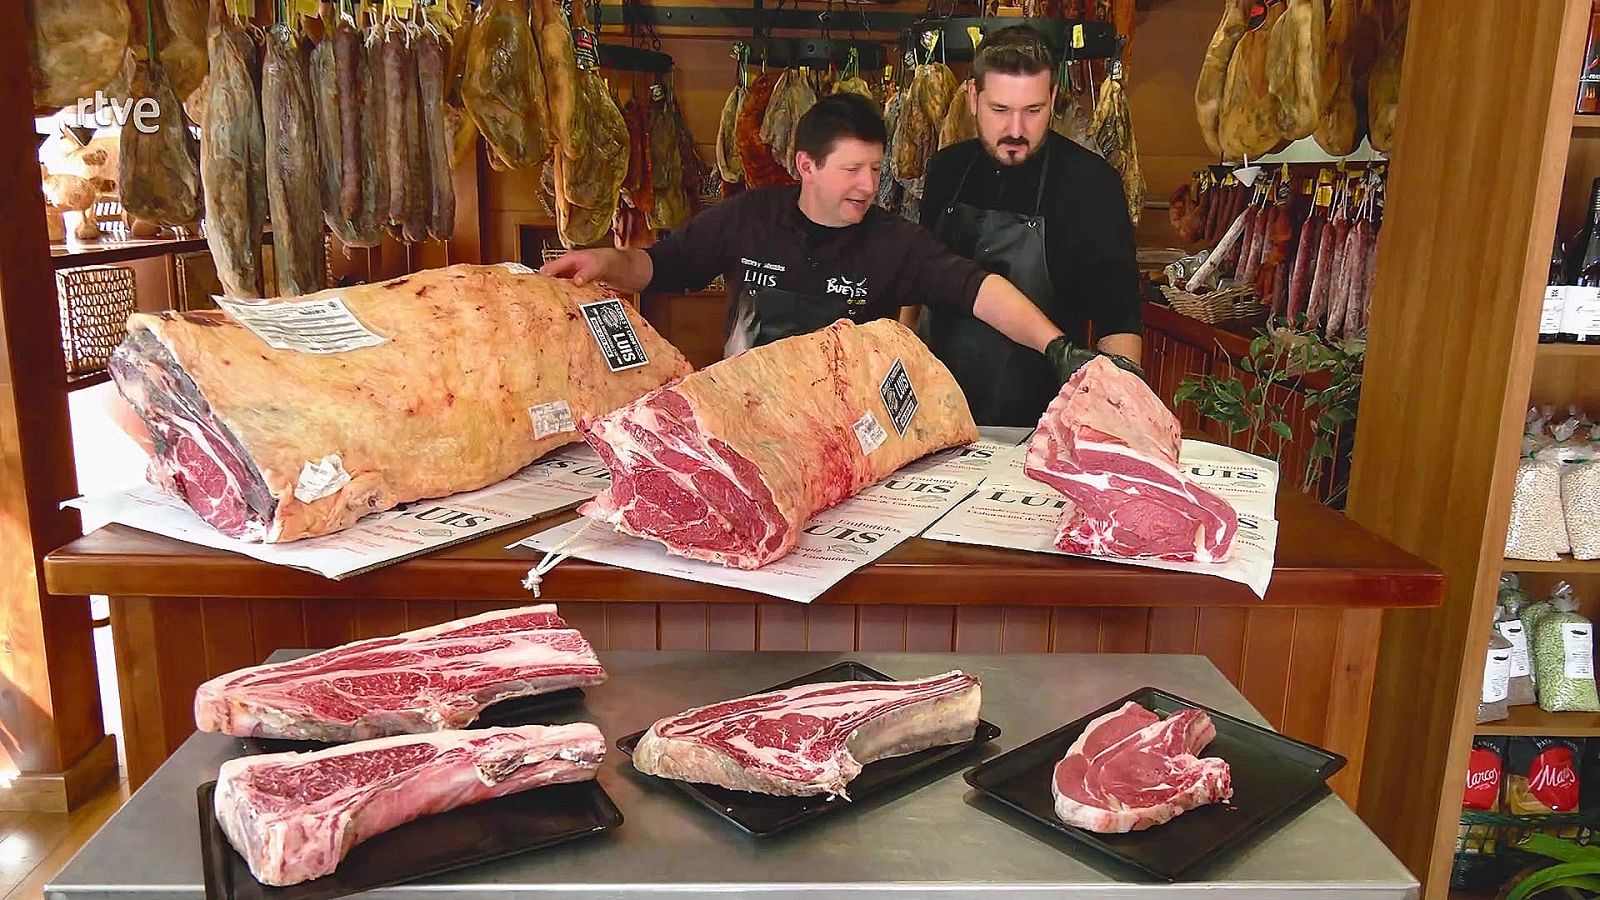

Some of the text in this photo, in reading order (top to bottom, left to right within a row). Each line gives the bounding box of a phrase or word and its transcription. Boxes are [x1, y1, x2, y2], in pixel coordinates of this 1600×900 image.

[612, 332, 637, 362] LUIS
[1190, 467, 1259, 480] UIS
[884, 479, 955, 495] UIS
[986, 491, 1067, 509] LUI
[414, 506, 492, 528] UIS
[803, 524, 886, 544] UIS
[1466, 766, 1499, 789] arcos
